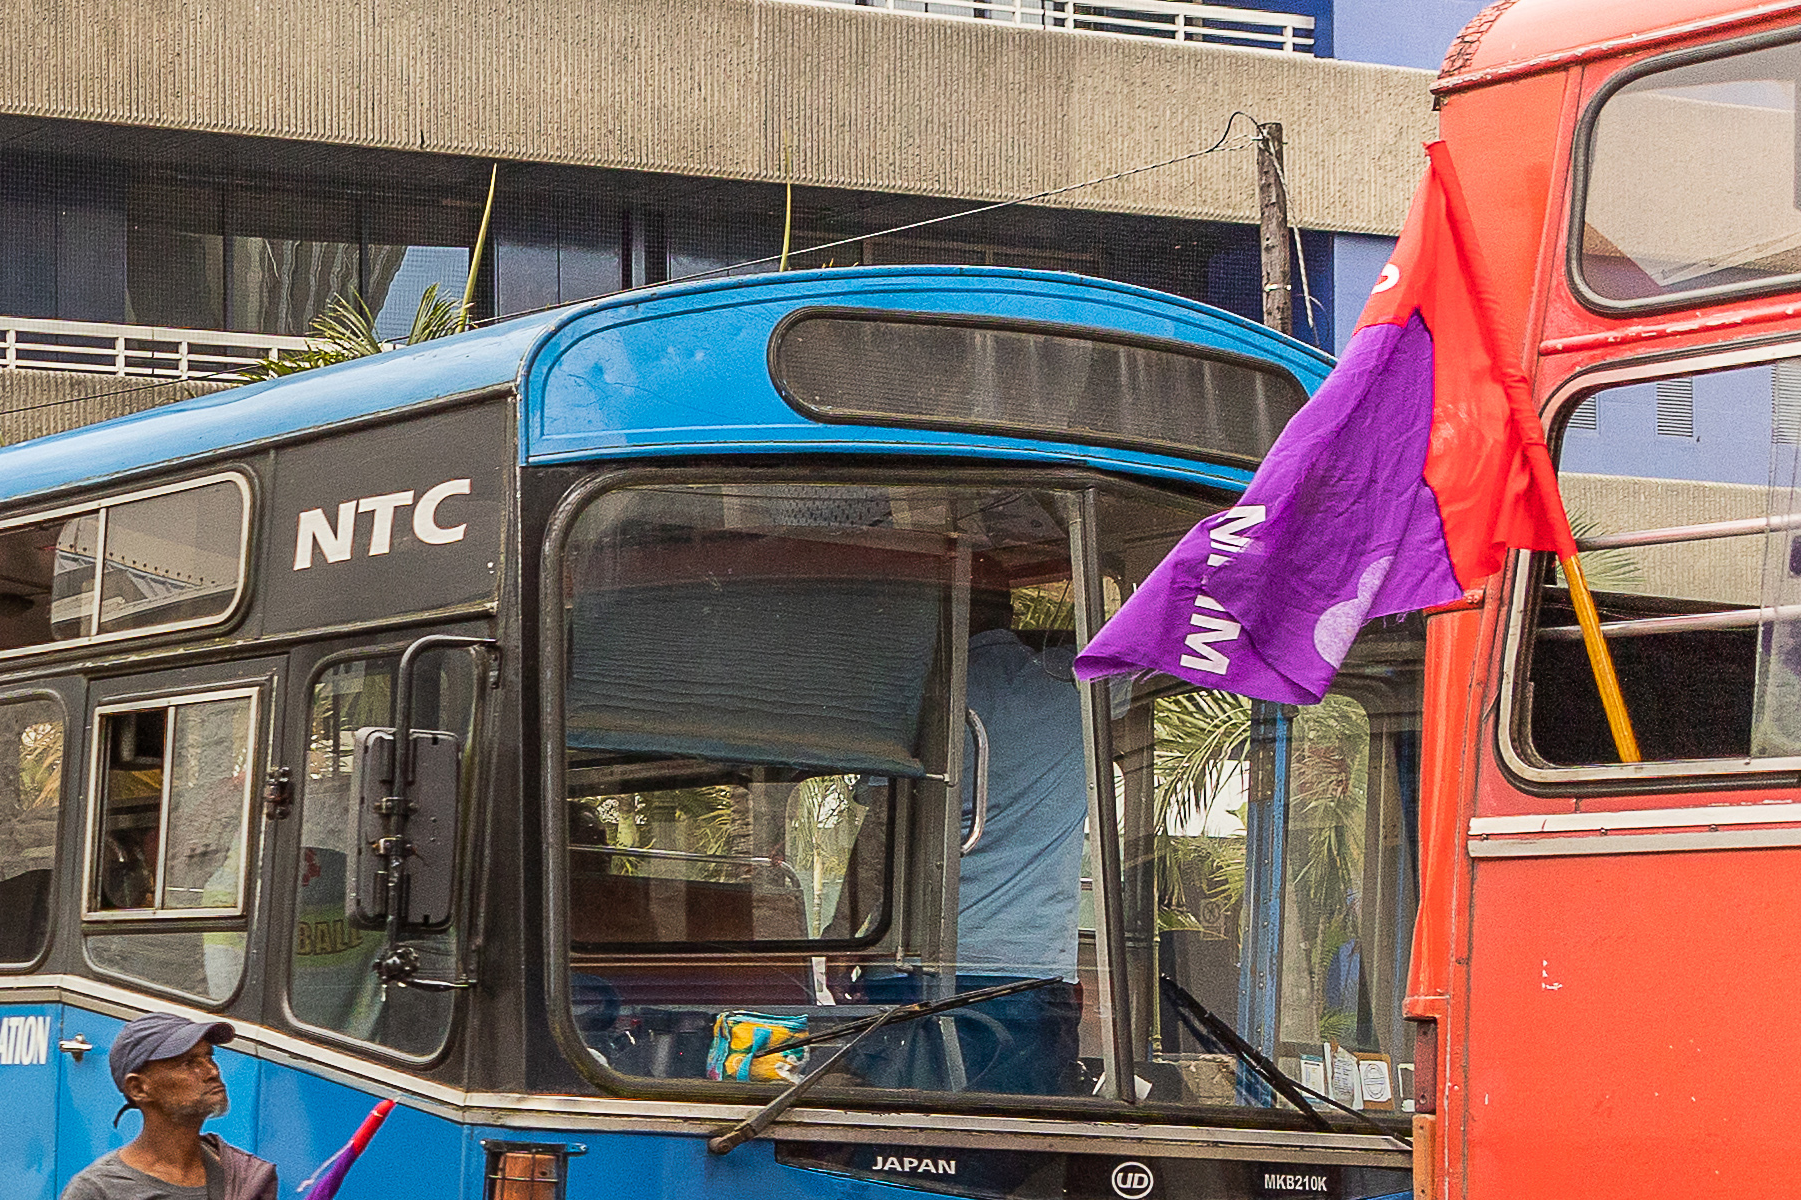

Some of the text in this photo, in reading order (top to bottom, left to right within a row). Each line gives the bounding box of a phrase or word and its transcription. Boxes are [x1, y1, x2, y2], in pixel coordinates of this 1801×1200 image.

[293, 479, 471, 571] NTC
[872, 1156, 957, 1175] JAPAN
[1264, 1173, 1328, 1192] MKB210K
